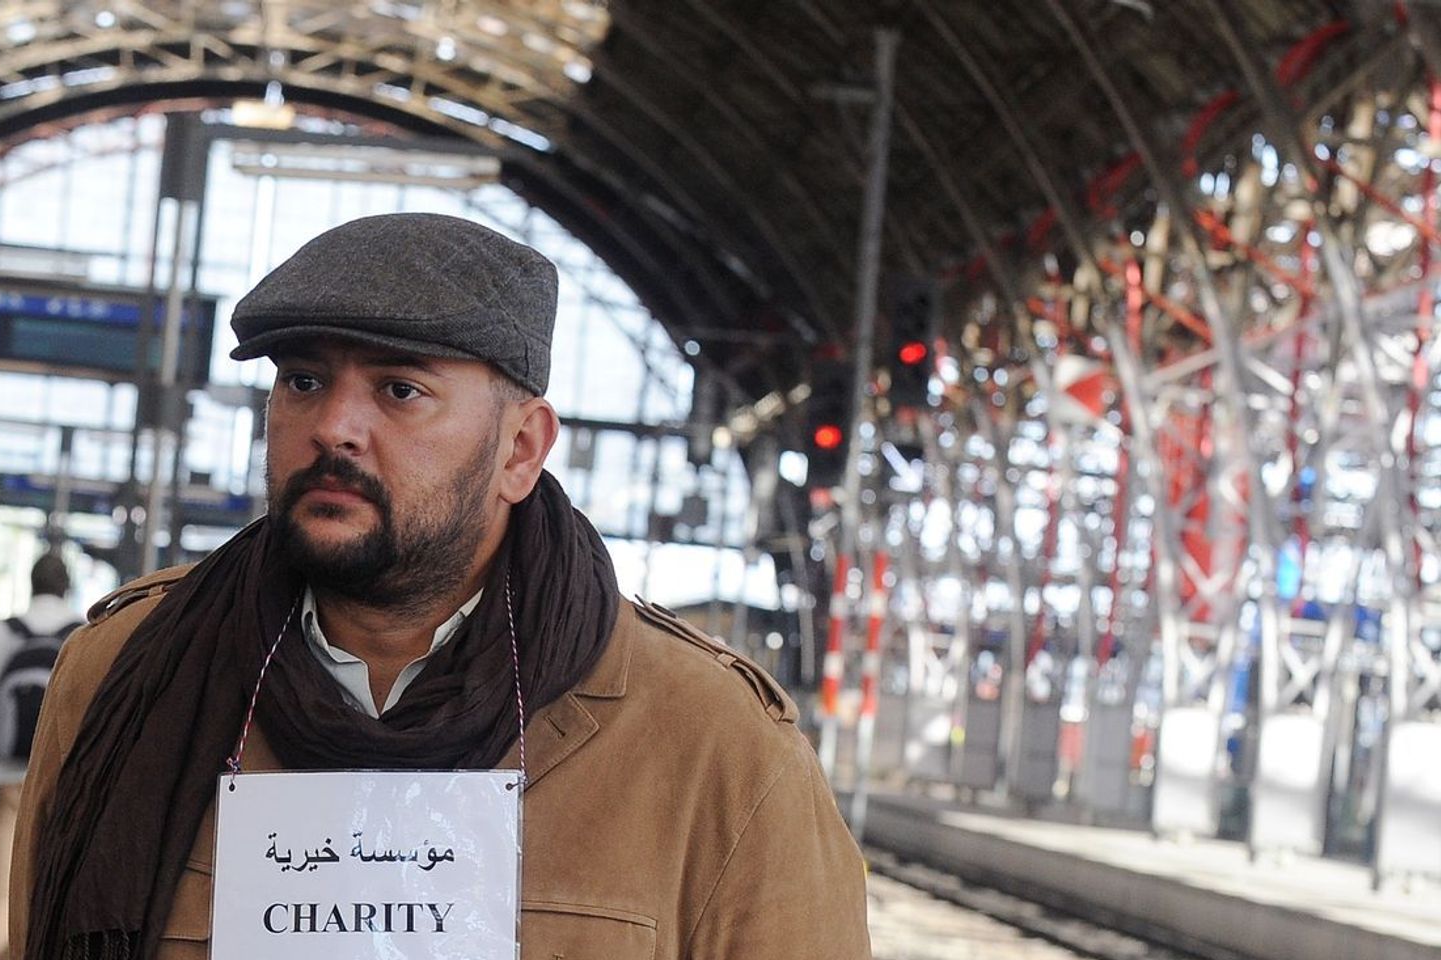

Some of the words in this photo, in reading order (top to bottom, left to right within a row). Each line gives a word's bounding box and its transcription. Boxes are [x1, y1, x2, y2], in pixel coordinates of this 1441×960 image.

[265, 832, 340, 872] خيرية
[350, 831, 455, 871] مؤسسة
[263, 902, 454, 934] CHARITY
